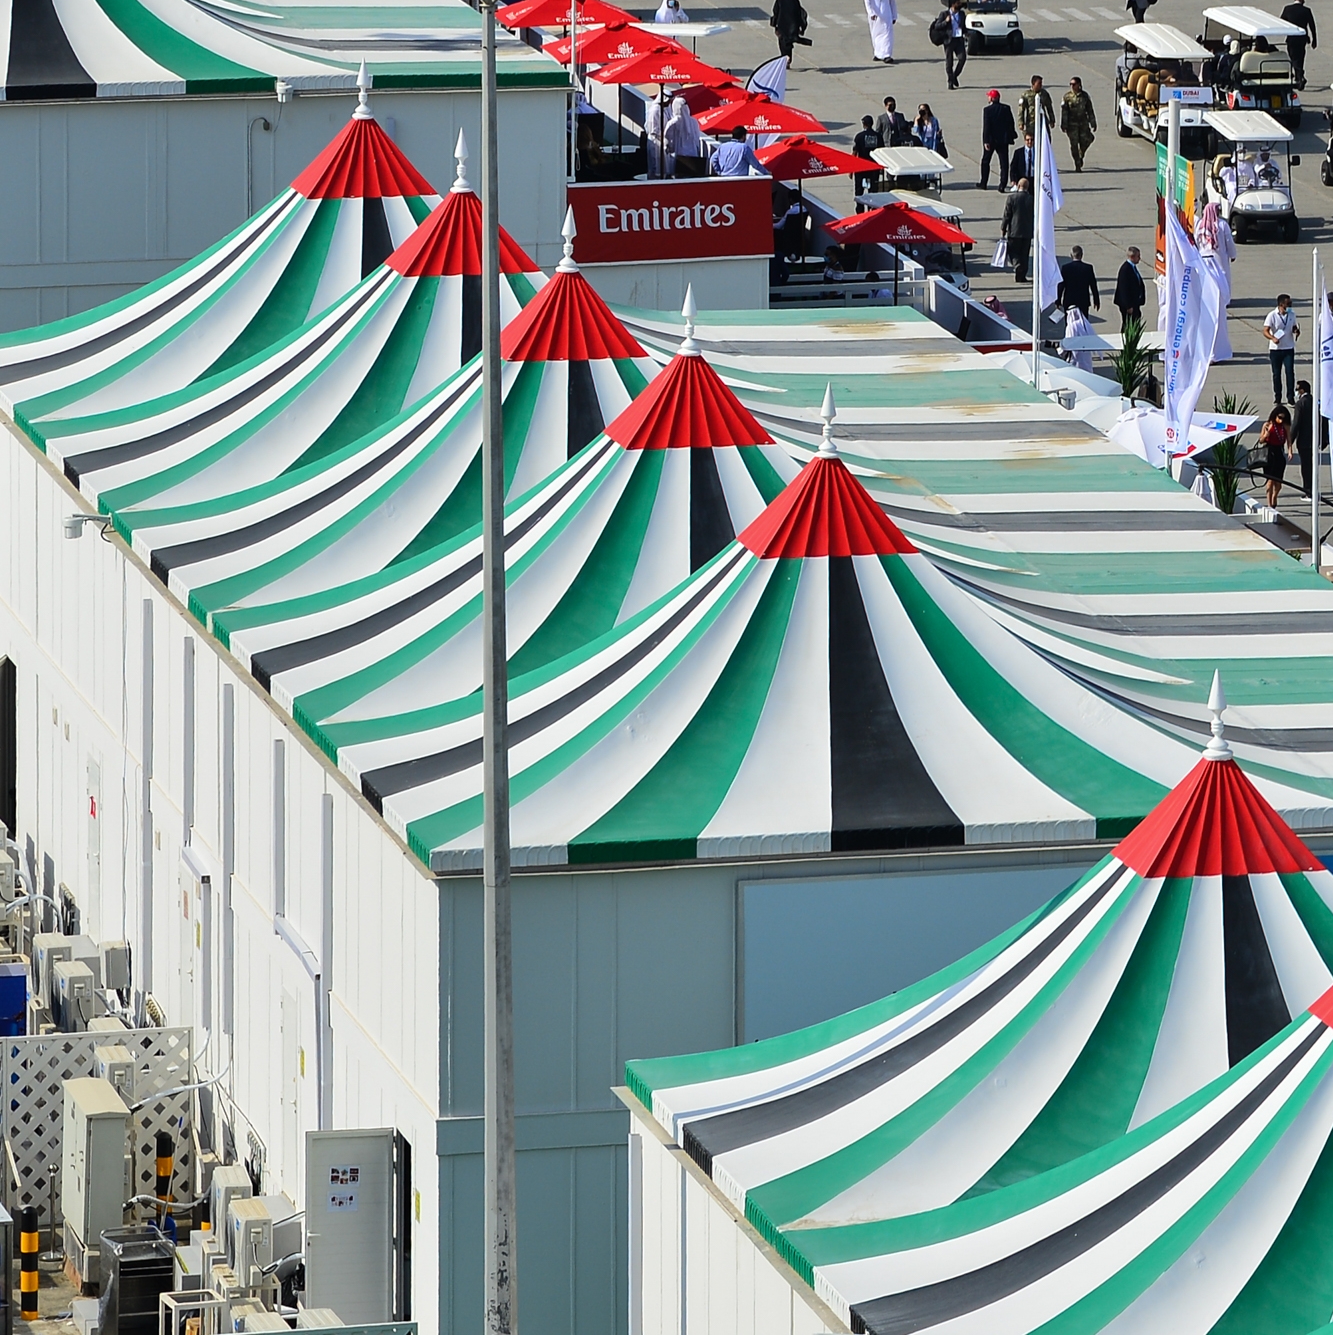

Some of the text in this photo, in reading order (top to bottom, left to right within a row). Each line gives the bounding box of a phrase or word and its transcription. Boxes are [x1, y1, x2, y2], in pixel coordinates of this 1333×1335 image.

[556, 16, 595, 24] Emrates
[650, 73, 691, 81] Emirates
[598, 201, 737, 233] Emirates
[886, 232, 927, 241] Emirates
